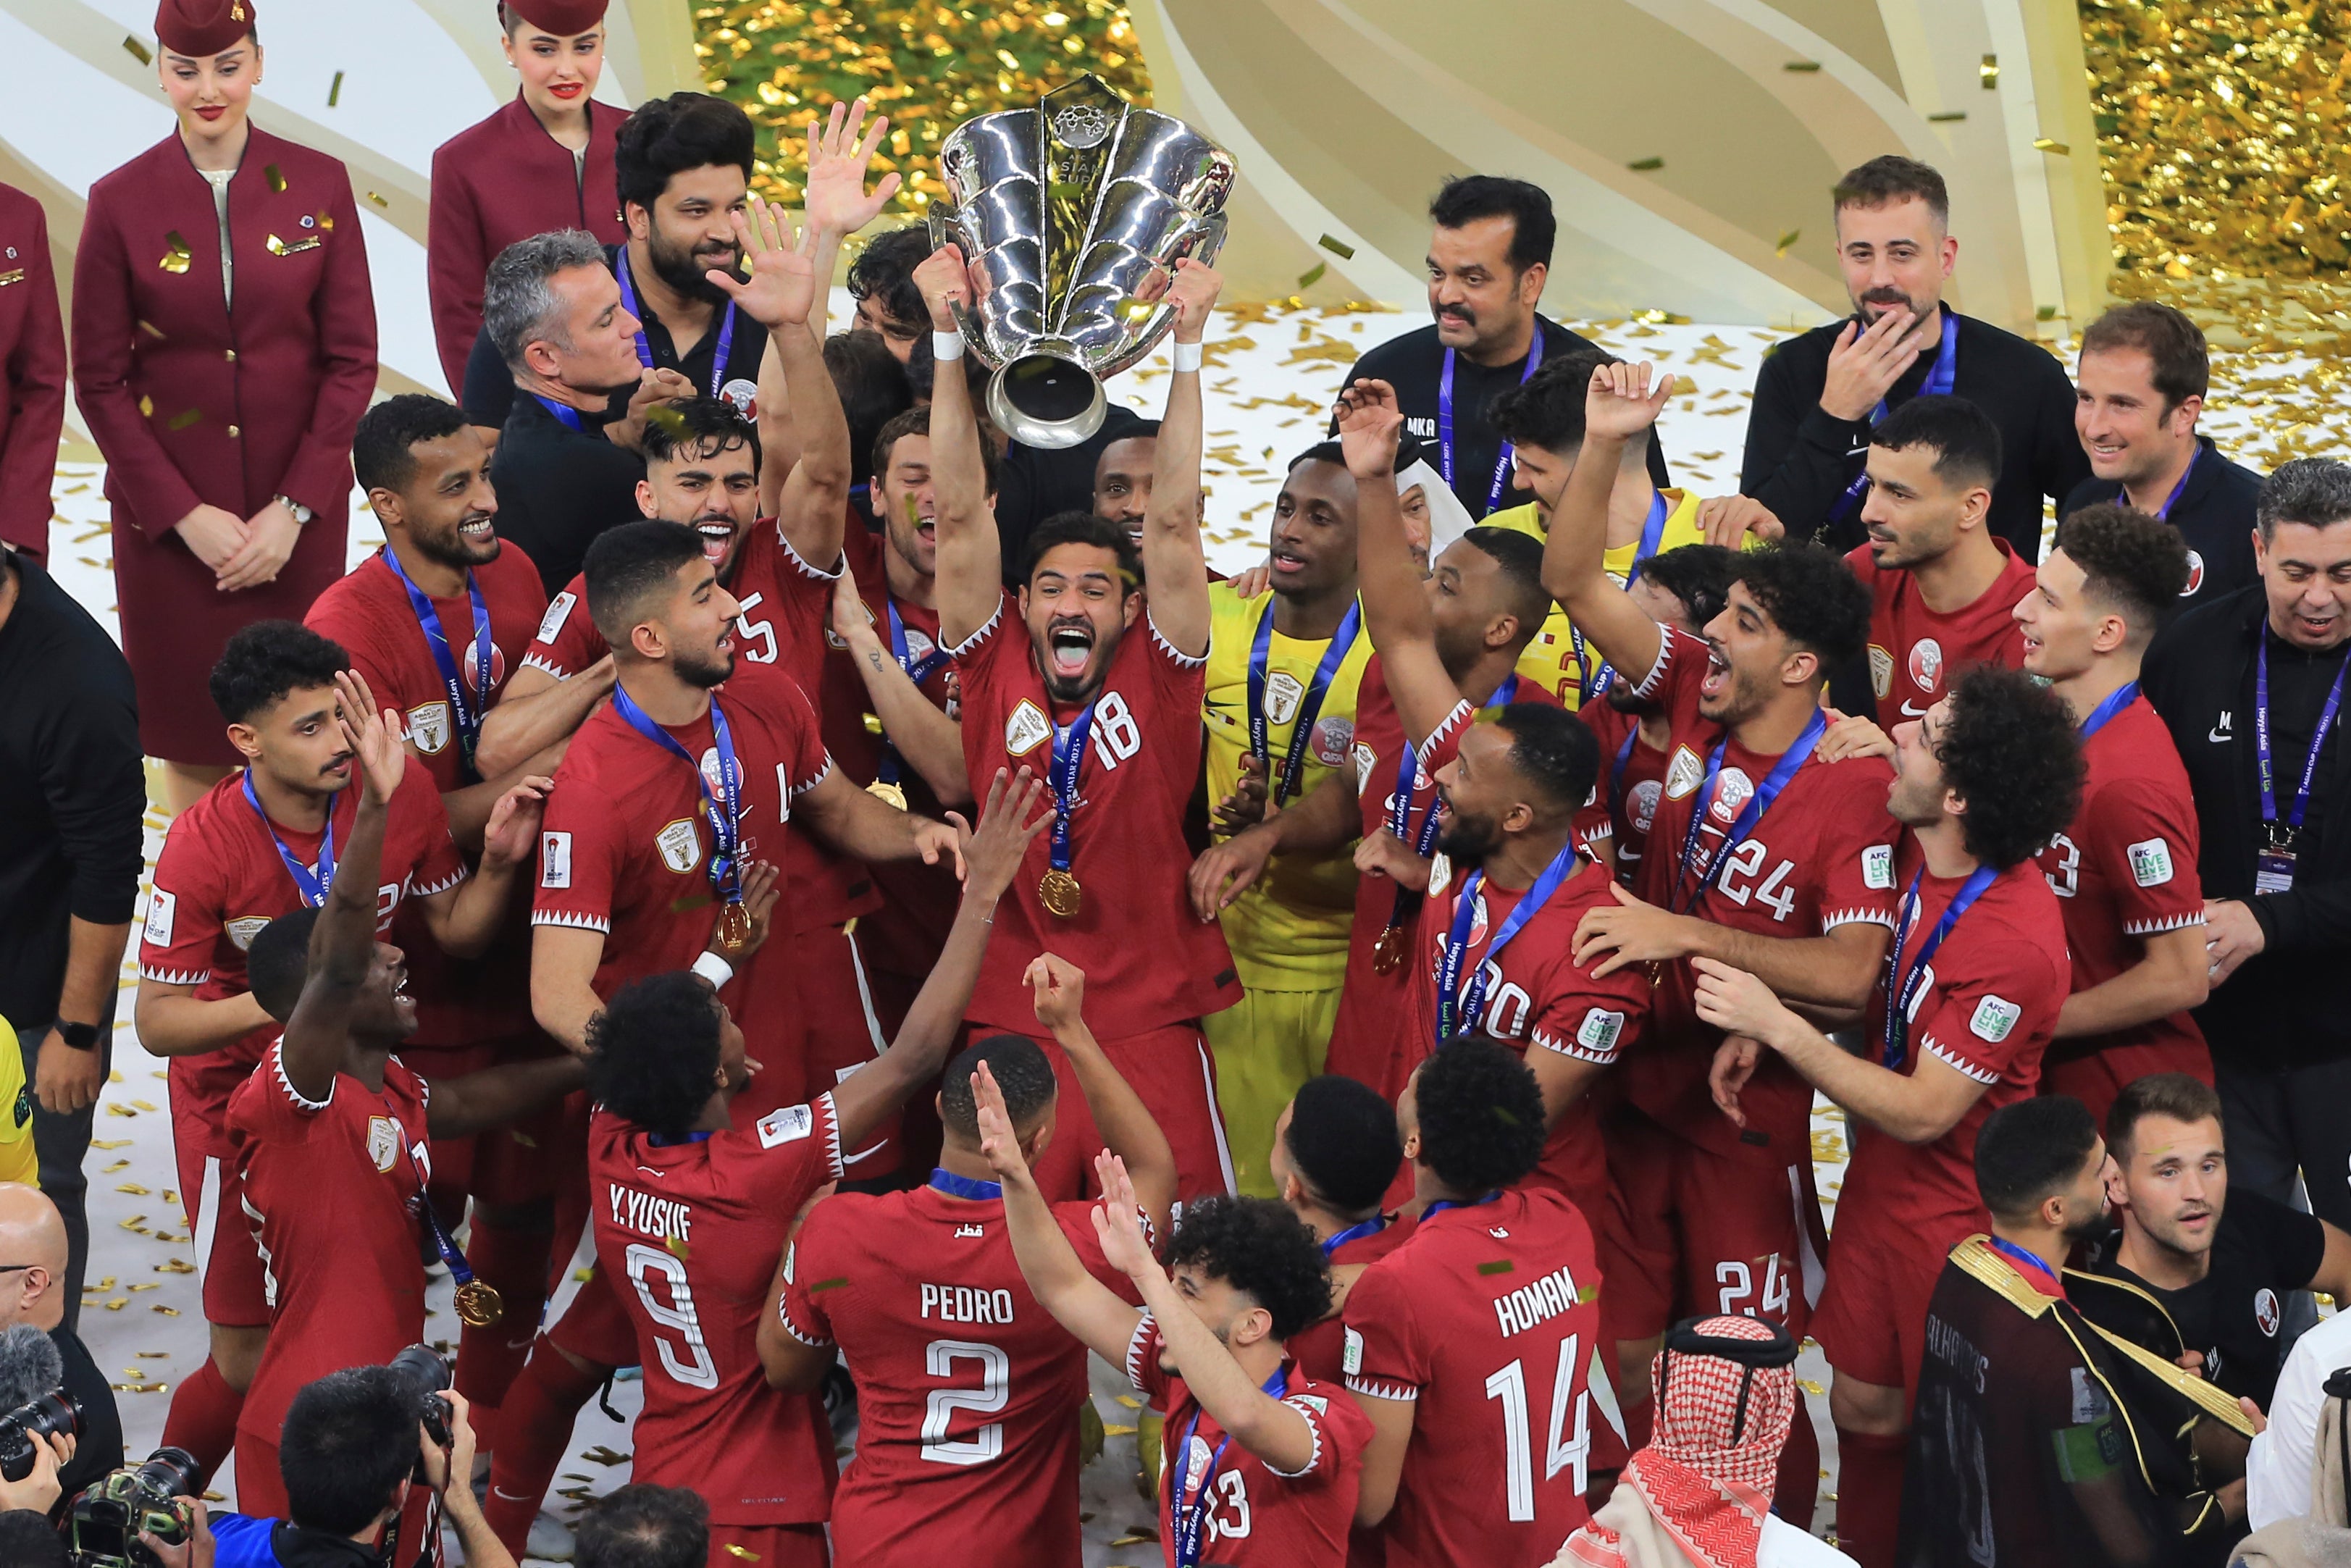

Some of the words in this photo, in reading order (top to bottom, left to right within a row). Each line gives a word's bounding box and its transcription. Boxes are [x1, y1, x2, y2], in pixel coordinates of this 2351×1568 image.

[1052, 161, 1099, 173] ASIAN
[1058, 174, 1091, 185] CUP
[1407, 417, 1436, 437] MKA
[1495, 457, 1509, 482] Hayya
[1491, 482, 1501, 498] Asia
[1595, 673, 1607, 691] CUP
[449, 679, 461, 707] Hayya
[457, 708, 466, 726] Asia
[1089, 691, 1141, 771] 18
[1251, 718, 1262, 747] Hayya
[2258, 707, 2266, 737] Hayya
[2259, 737, 2268, 751] Asia
[1322, 752, 1345, 763] QFA
[2305, 766, 2313, 787] ASIAN
[2313, 732, 2323, 752] QATAR
[725, 762, 734, 784] 2023
[1067, 765, 1078, 795] QATAR
[709, 807, 724, 834] Hayya
[1396, 795, 1407, 823] Hayya
[1713, 801, 1733, 821] QFA
[1420, 824, 1434, 851] QATAR
[1718, 838, 1734, 864] Hayya
[2134, 849, 2150, 858] AFC
[2136, 854, 2163, 869] LIVE
[1706, 863, 1719, 881] Asia
[1718, 839, 1795, 922] 24
[1447, 942, 1462, 971] Hayya
[1443, 971, 1455, 991] Asia
[1903, 966, 1919, 994] Hayya
[1467, 988, 1481, 1015] QATAR
[1899, 993, 1908, 1010] Asia
[1987, 1001, 2005, 1014] AFC
[1589, 1020, 1615, 1036] LIVE
[1593, 1015, 1611, 1025] AFC
[1982, 1007, 2011, 1026] LIVE
[610, 1183, 692, 1241] Y.YUSUF
[954, 1224, 984, 1238] قطر
[1716, 1252, 1790, 1317] 24
[921, 1283, 1015, 1324] PEDRO
[1493, 1265, 1579, 1338] HOMAM
[626, 1243, 719, 1390] 9
[920, 1339, 1010, 1466] 2
[1485, 1332, 1592, 1522] 14
[1189, 1506, 1201, 1534] Hayya
[1186, 1535, 1196, 1556] Asia
